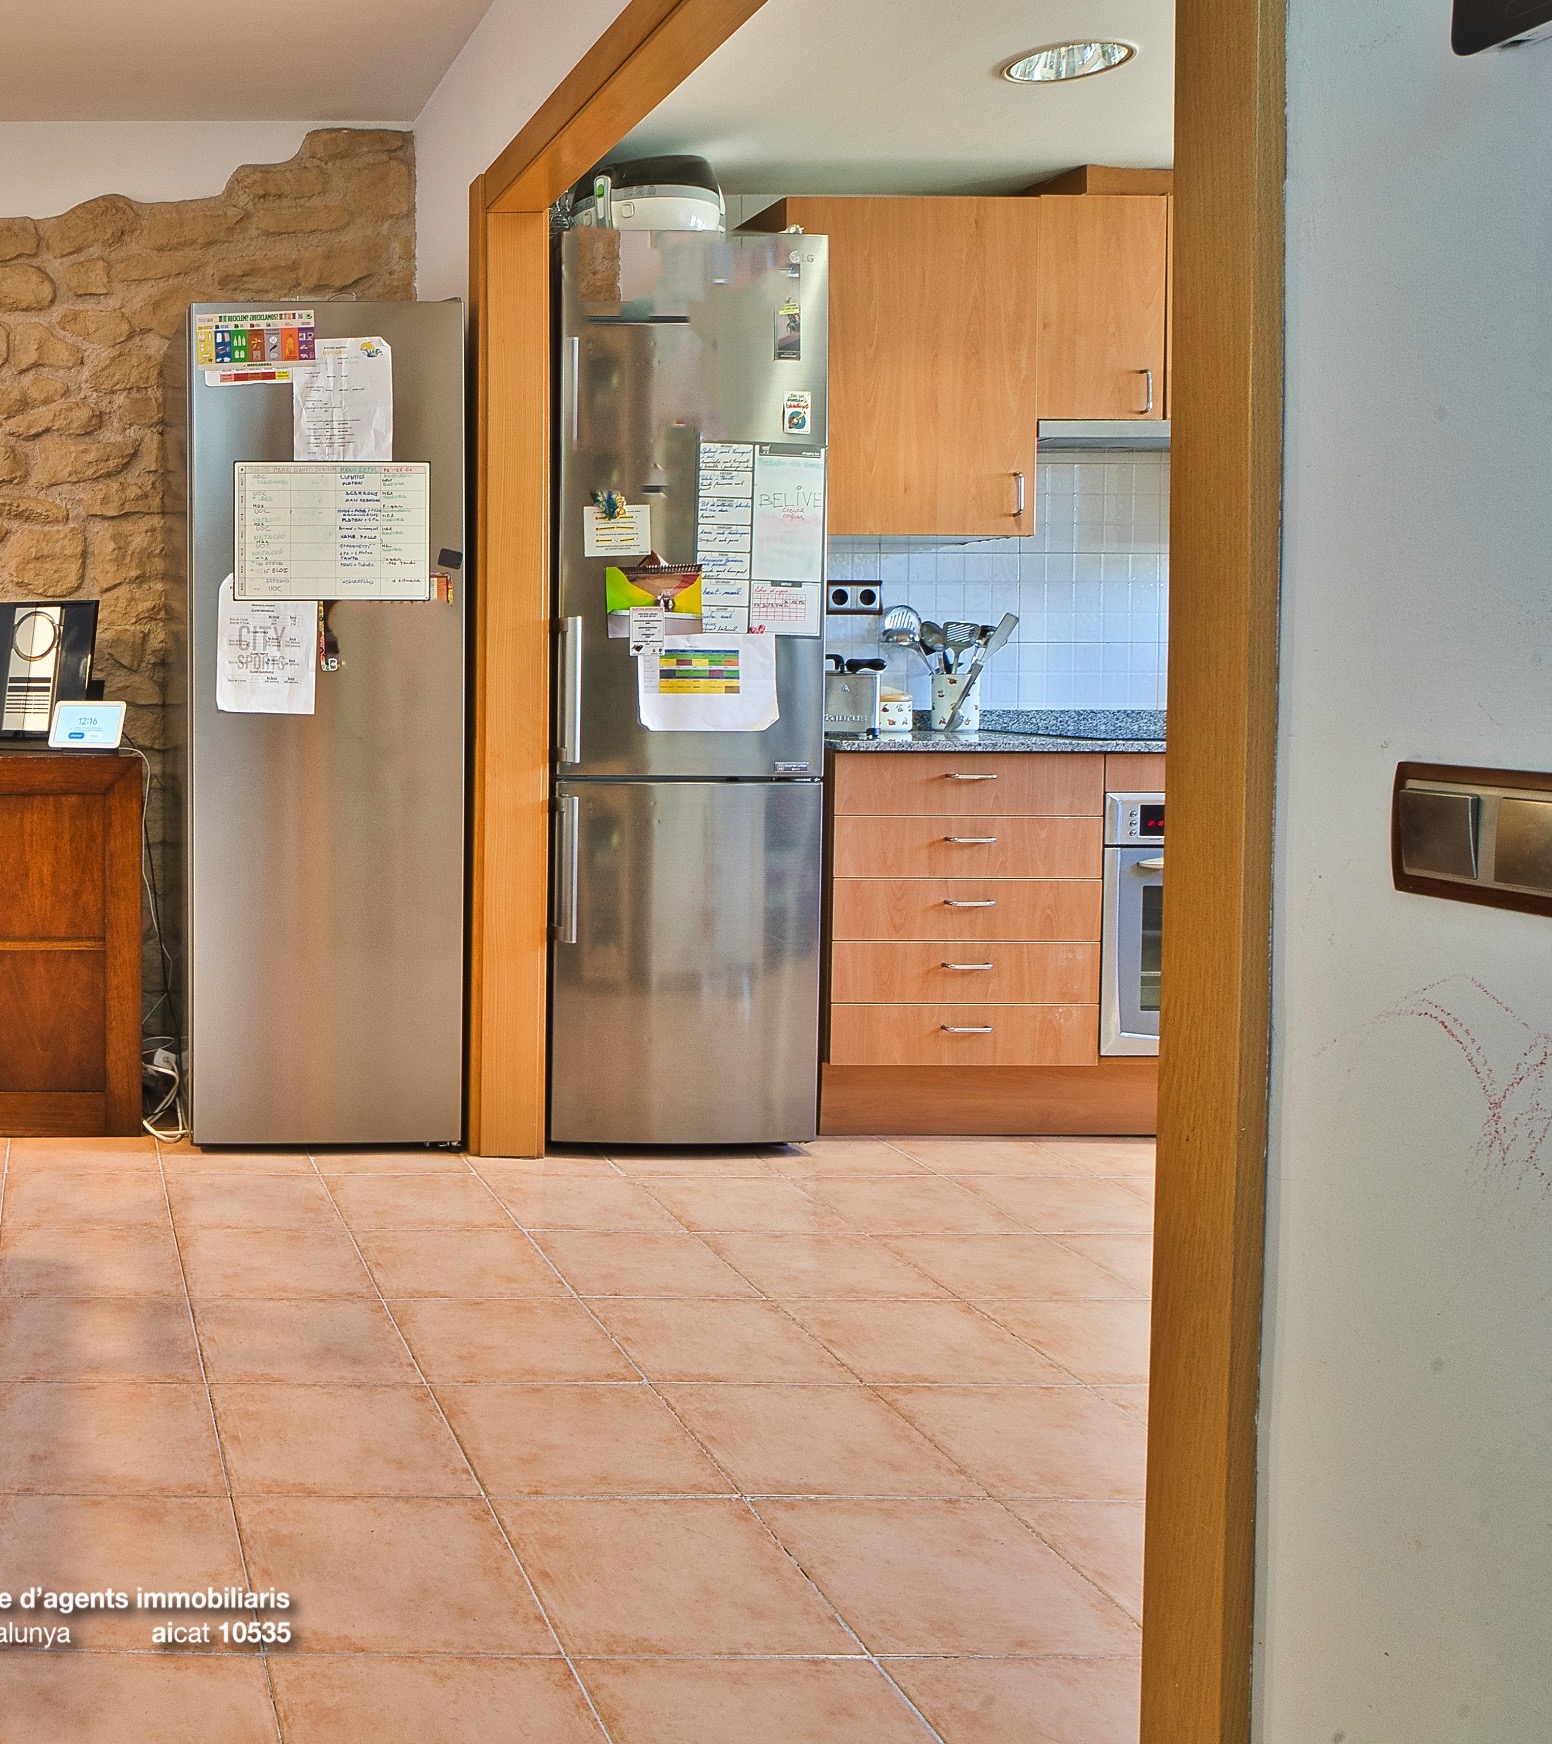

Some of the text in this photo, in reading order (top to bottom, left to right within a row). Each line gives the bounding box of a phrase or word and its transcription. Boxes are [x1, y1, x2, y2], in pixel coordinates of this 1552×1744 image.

[238, 625, 286, 652] CITY
[237, 654, 286, 671] SPORTS
[78, 717, 98, 726] 12:16
